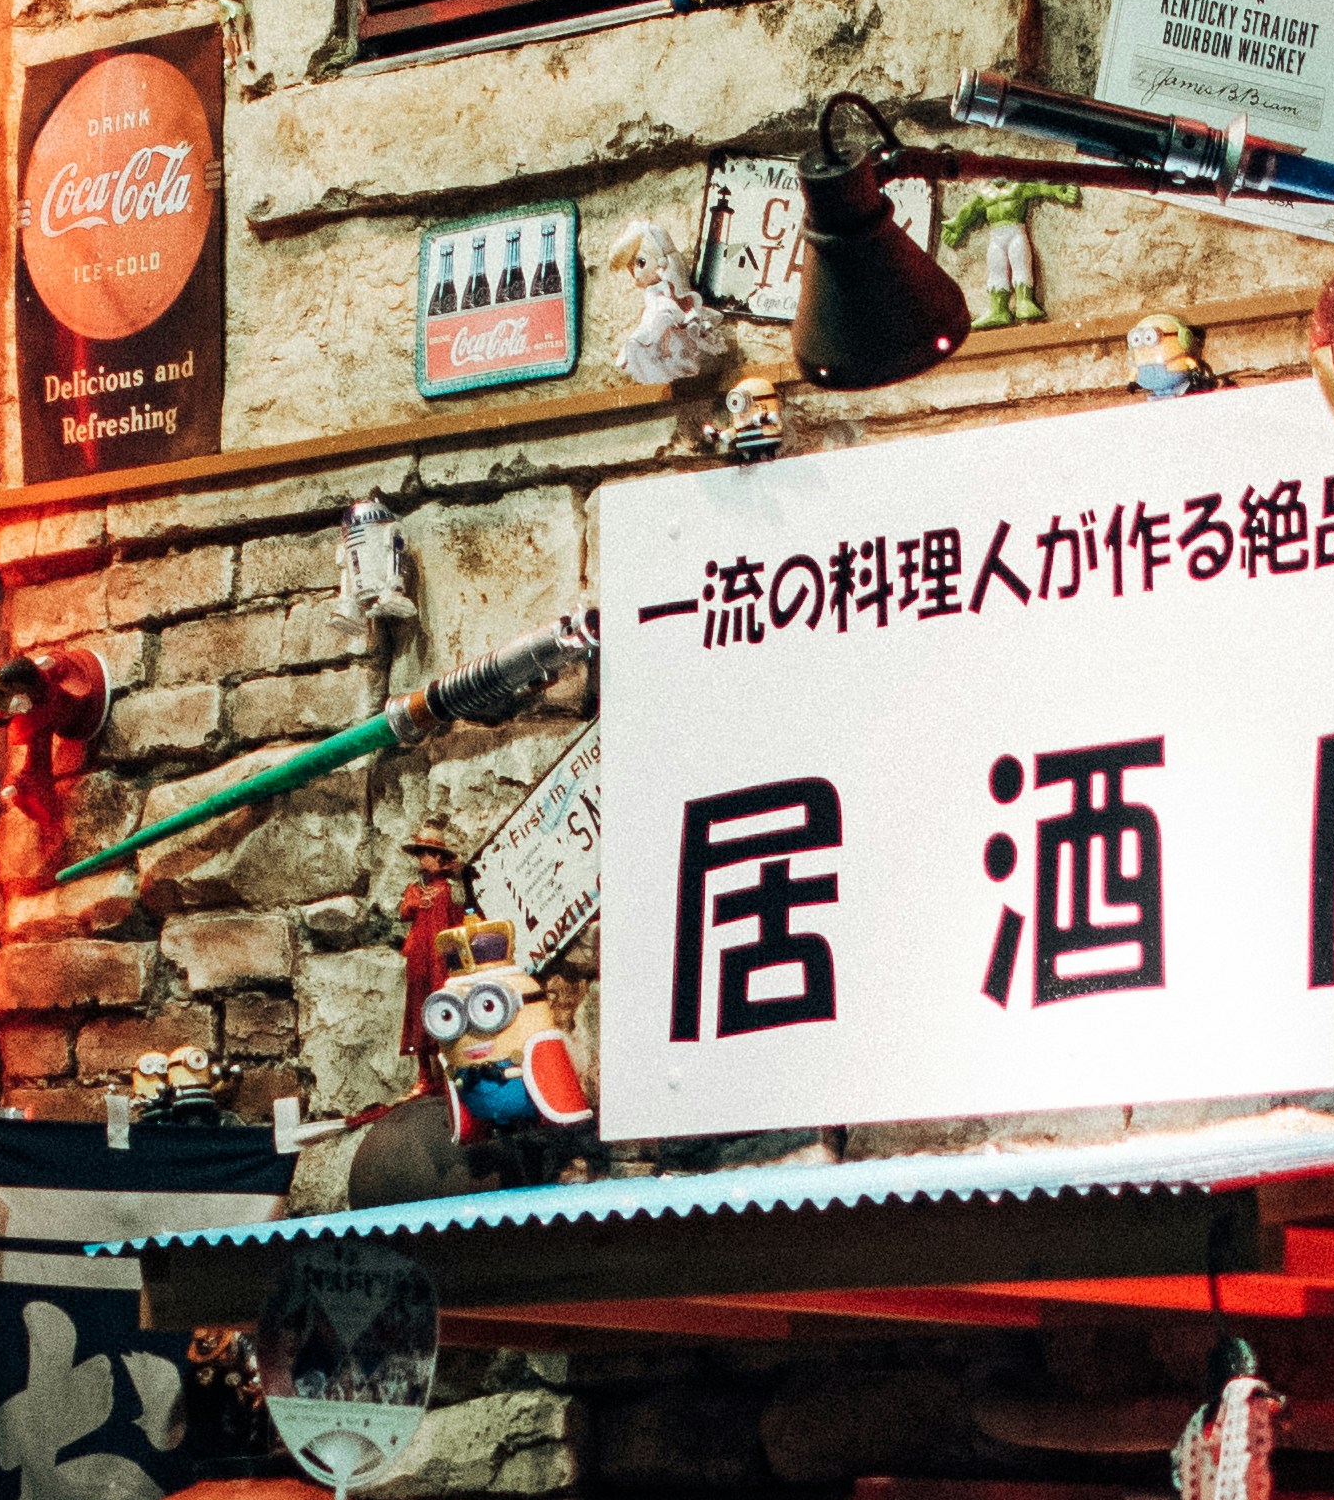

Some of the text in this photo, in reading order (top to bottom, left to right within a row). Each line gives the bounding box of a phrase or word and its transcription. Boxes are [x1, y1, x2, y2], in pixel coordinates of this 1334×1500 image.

[1163, 20, 1306, 76] BOURBON WHISKEY
[1242, 8, 1319, 48] STRAIGHT
[87, 109, 150, 136] DRINK
[40, 139, 196, 238] Coca-Cola
[73, 251, 160, 284] ICE-COLD
[451, 316, 529, 366] Coca-Cola
[44, 351, 194, 403] Delicious and
[61, 404, 178, 445] Refreshing
[509, 803, 545, 850] First
[528, 890, 594, 965] NORTH
